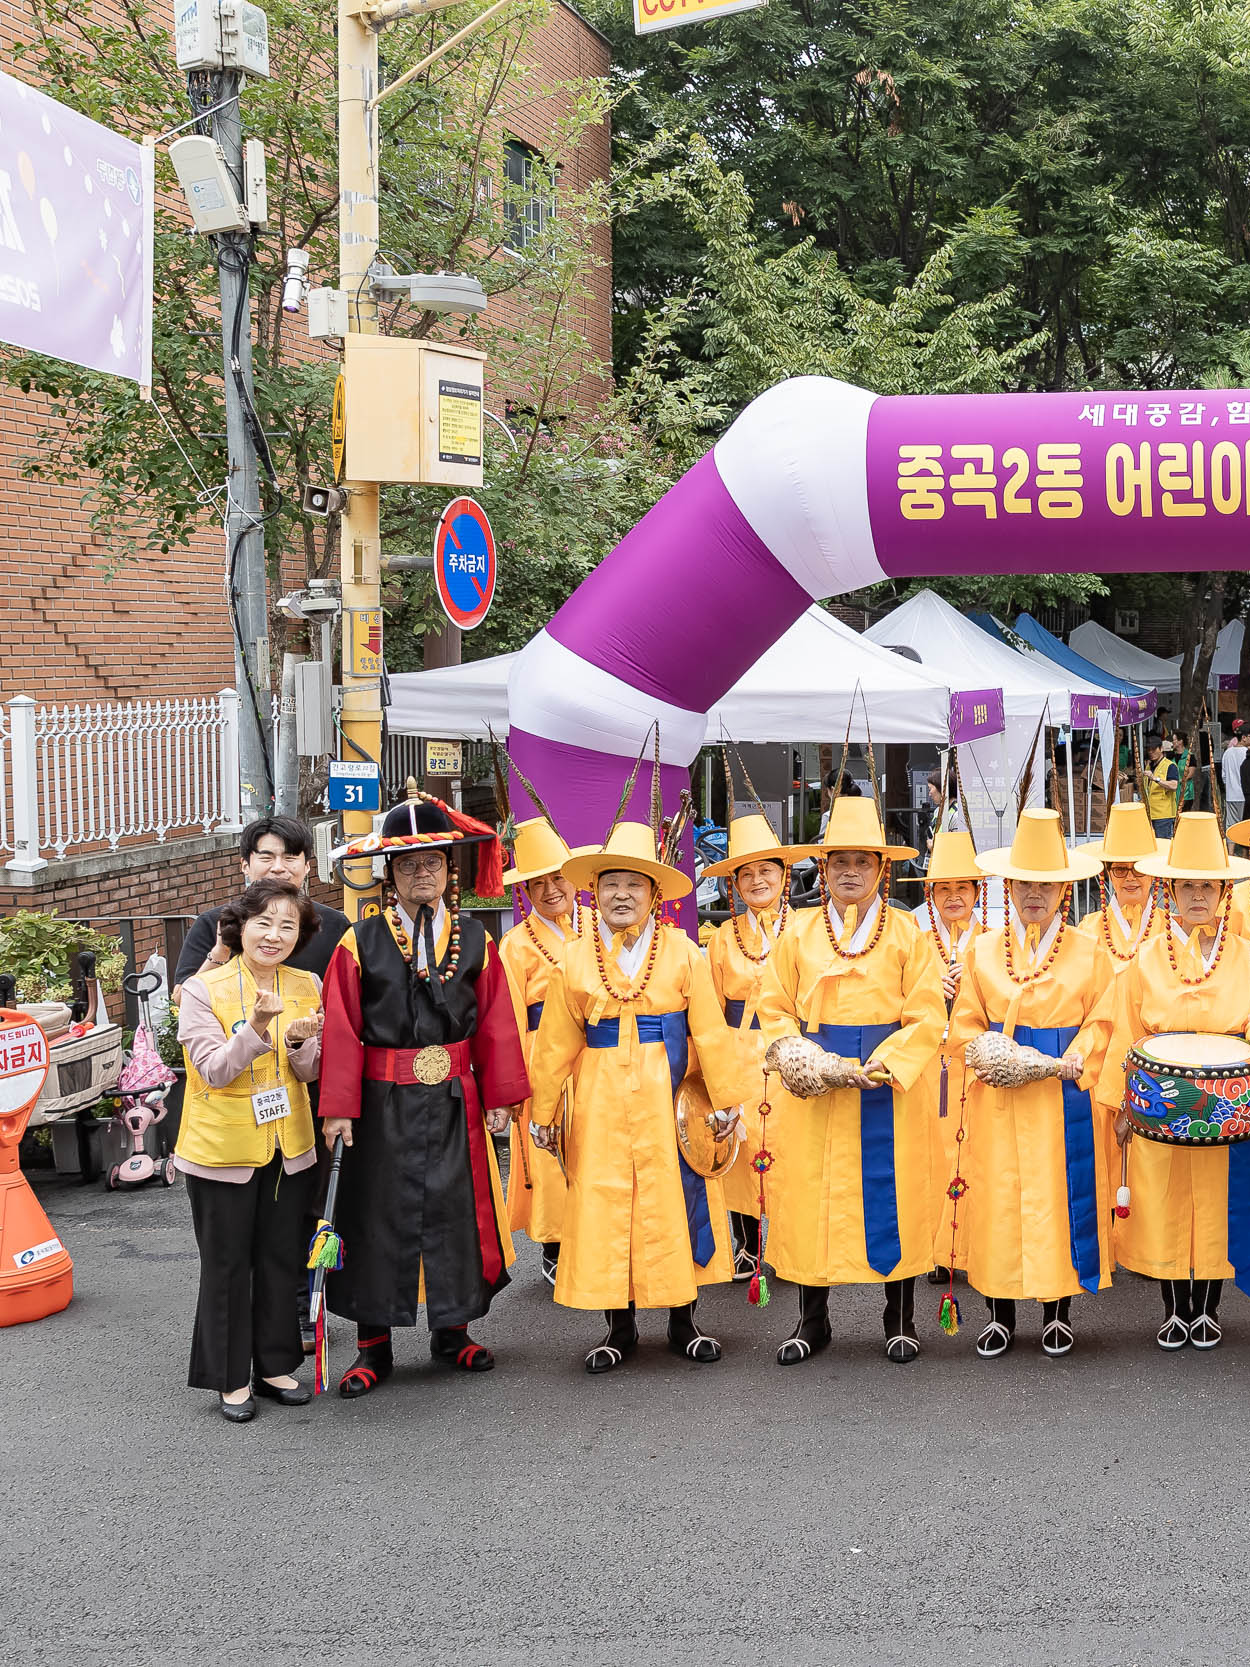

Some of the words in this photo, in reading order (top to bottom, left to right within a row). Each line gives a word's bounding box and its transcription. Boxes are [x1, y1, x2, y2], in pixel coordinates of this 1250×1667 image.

[896, 442, 1084, 520] 중곡2동
[448, 554, 486, 574] 주차금지
[344, 784, 363, 803] 31
[8, 1027, 35, 1041] 드립니다
[257, 1090, 283, 1106] 중곡2동
